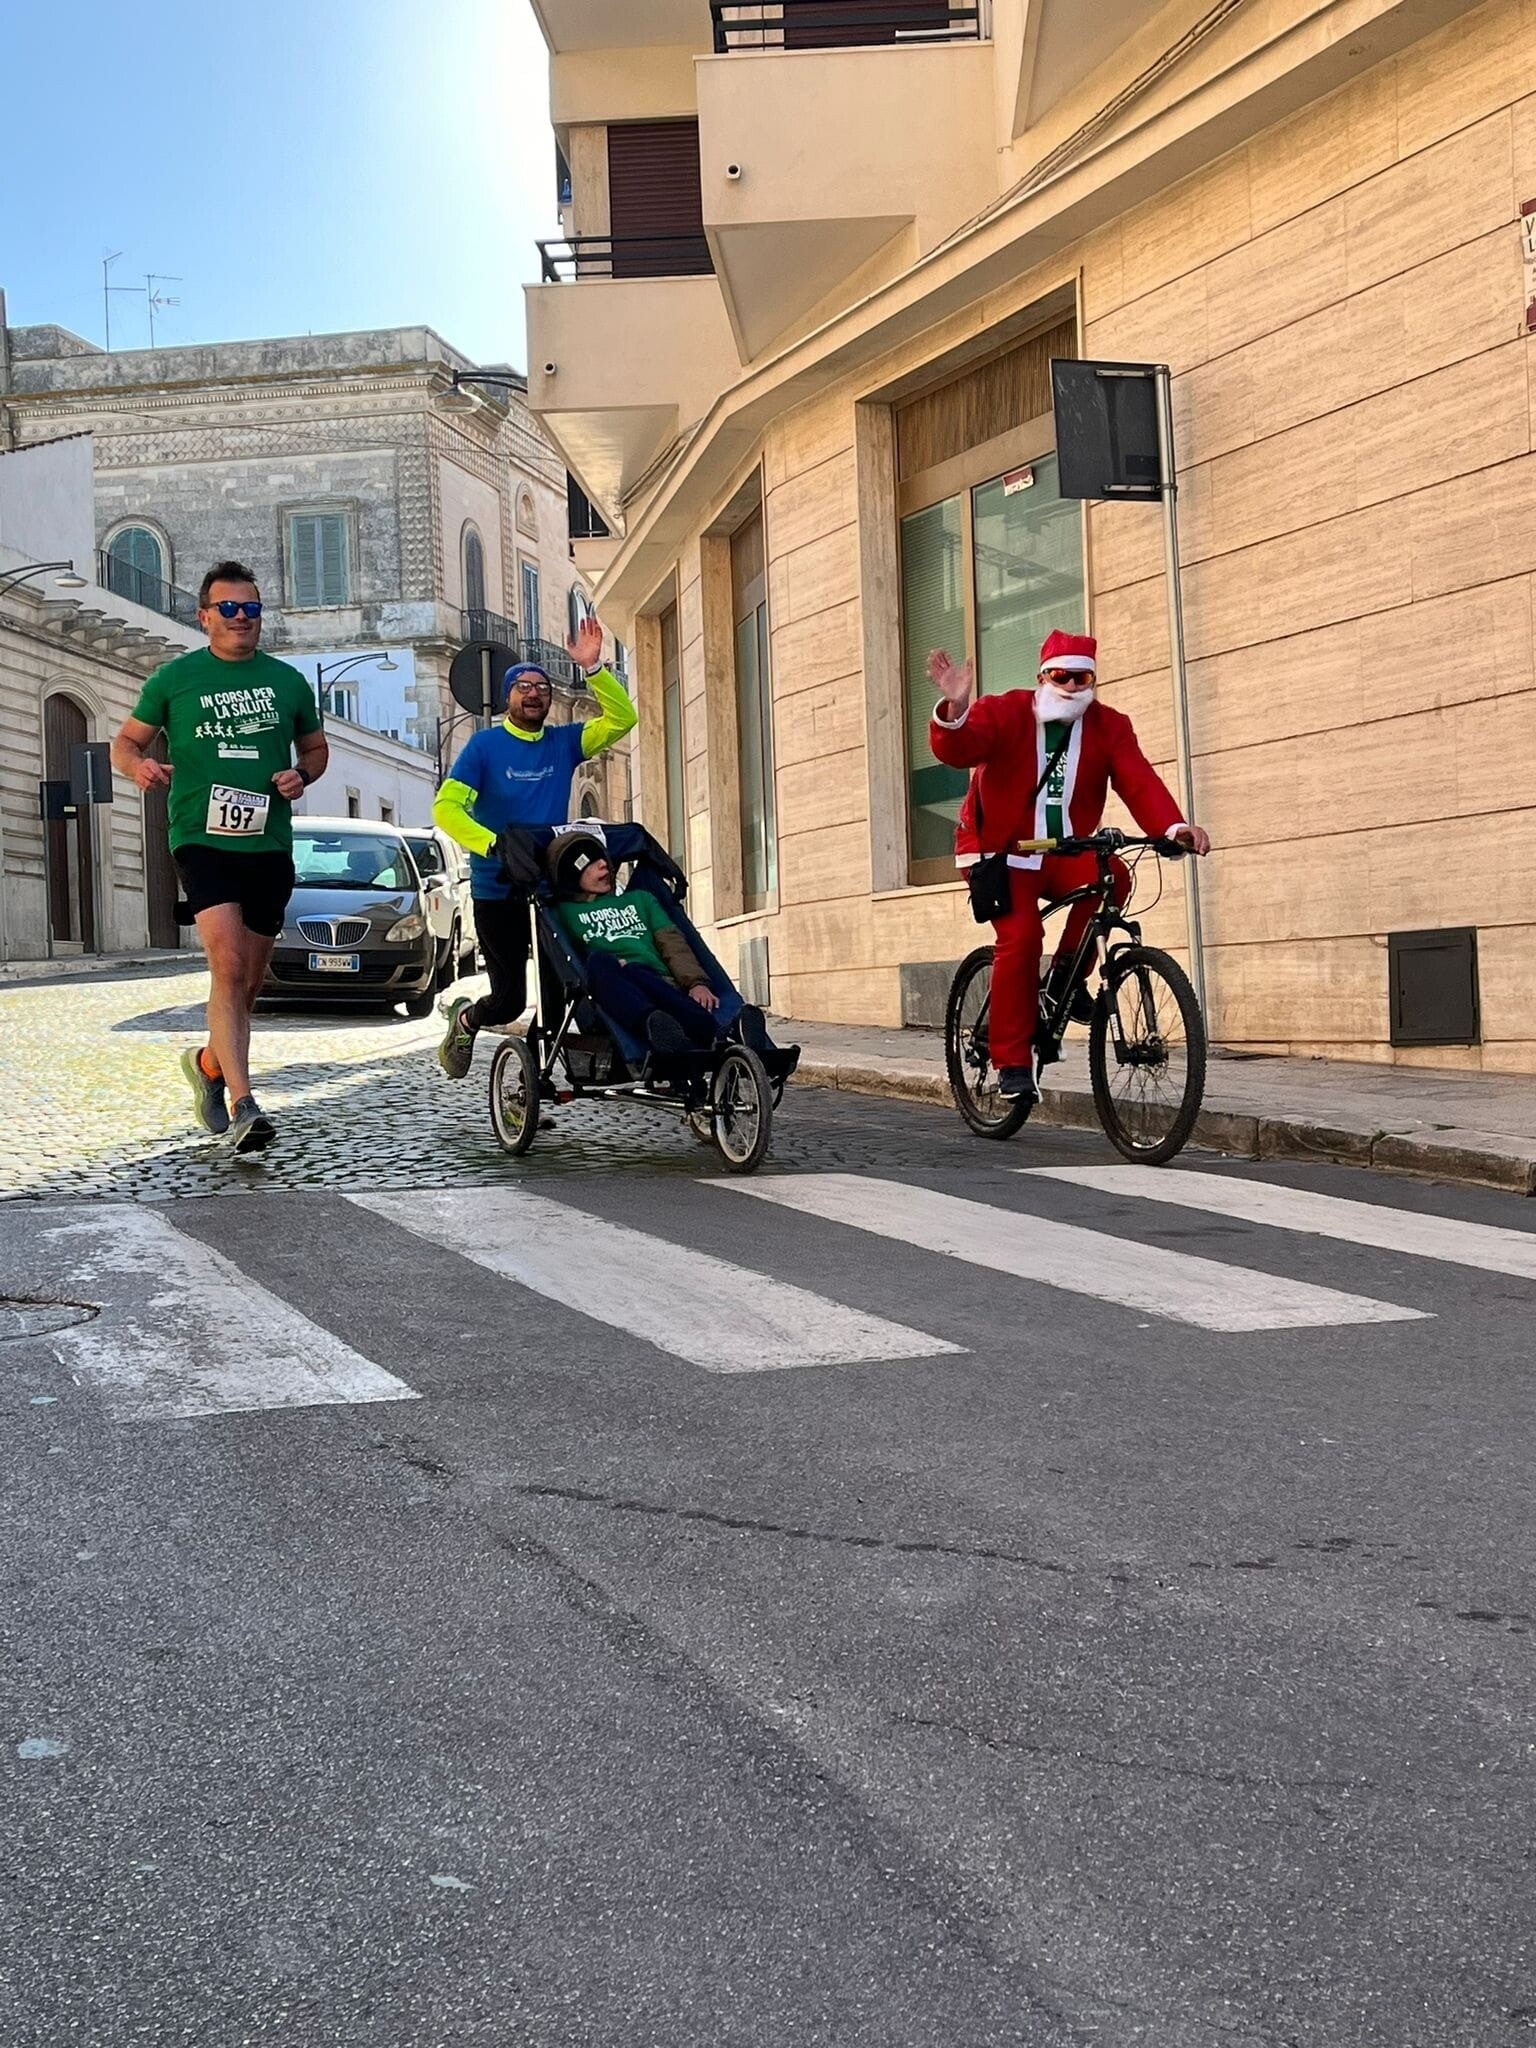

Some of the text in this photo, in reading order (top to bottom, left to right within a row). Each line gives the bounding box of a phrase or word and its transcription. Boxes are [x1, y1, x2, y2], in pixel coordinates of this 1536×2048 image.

[200, 687, 276, 709] IN CORSA PER
[213, 705, 231, 719] LA
[231, 698, 275, 717] SALUTE
[219, 803, 255, 830] 197
[578, 912, 591, 924] IN
[590, 907, 621, 922] CORSA
[604, 915, 641, 931] SALUTE
